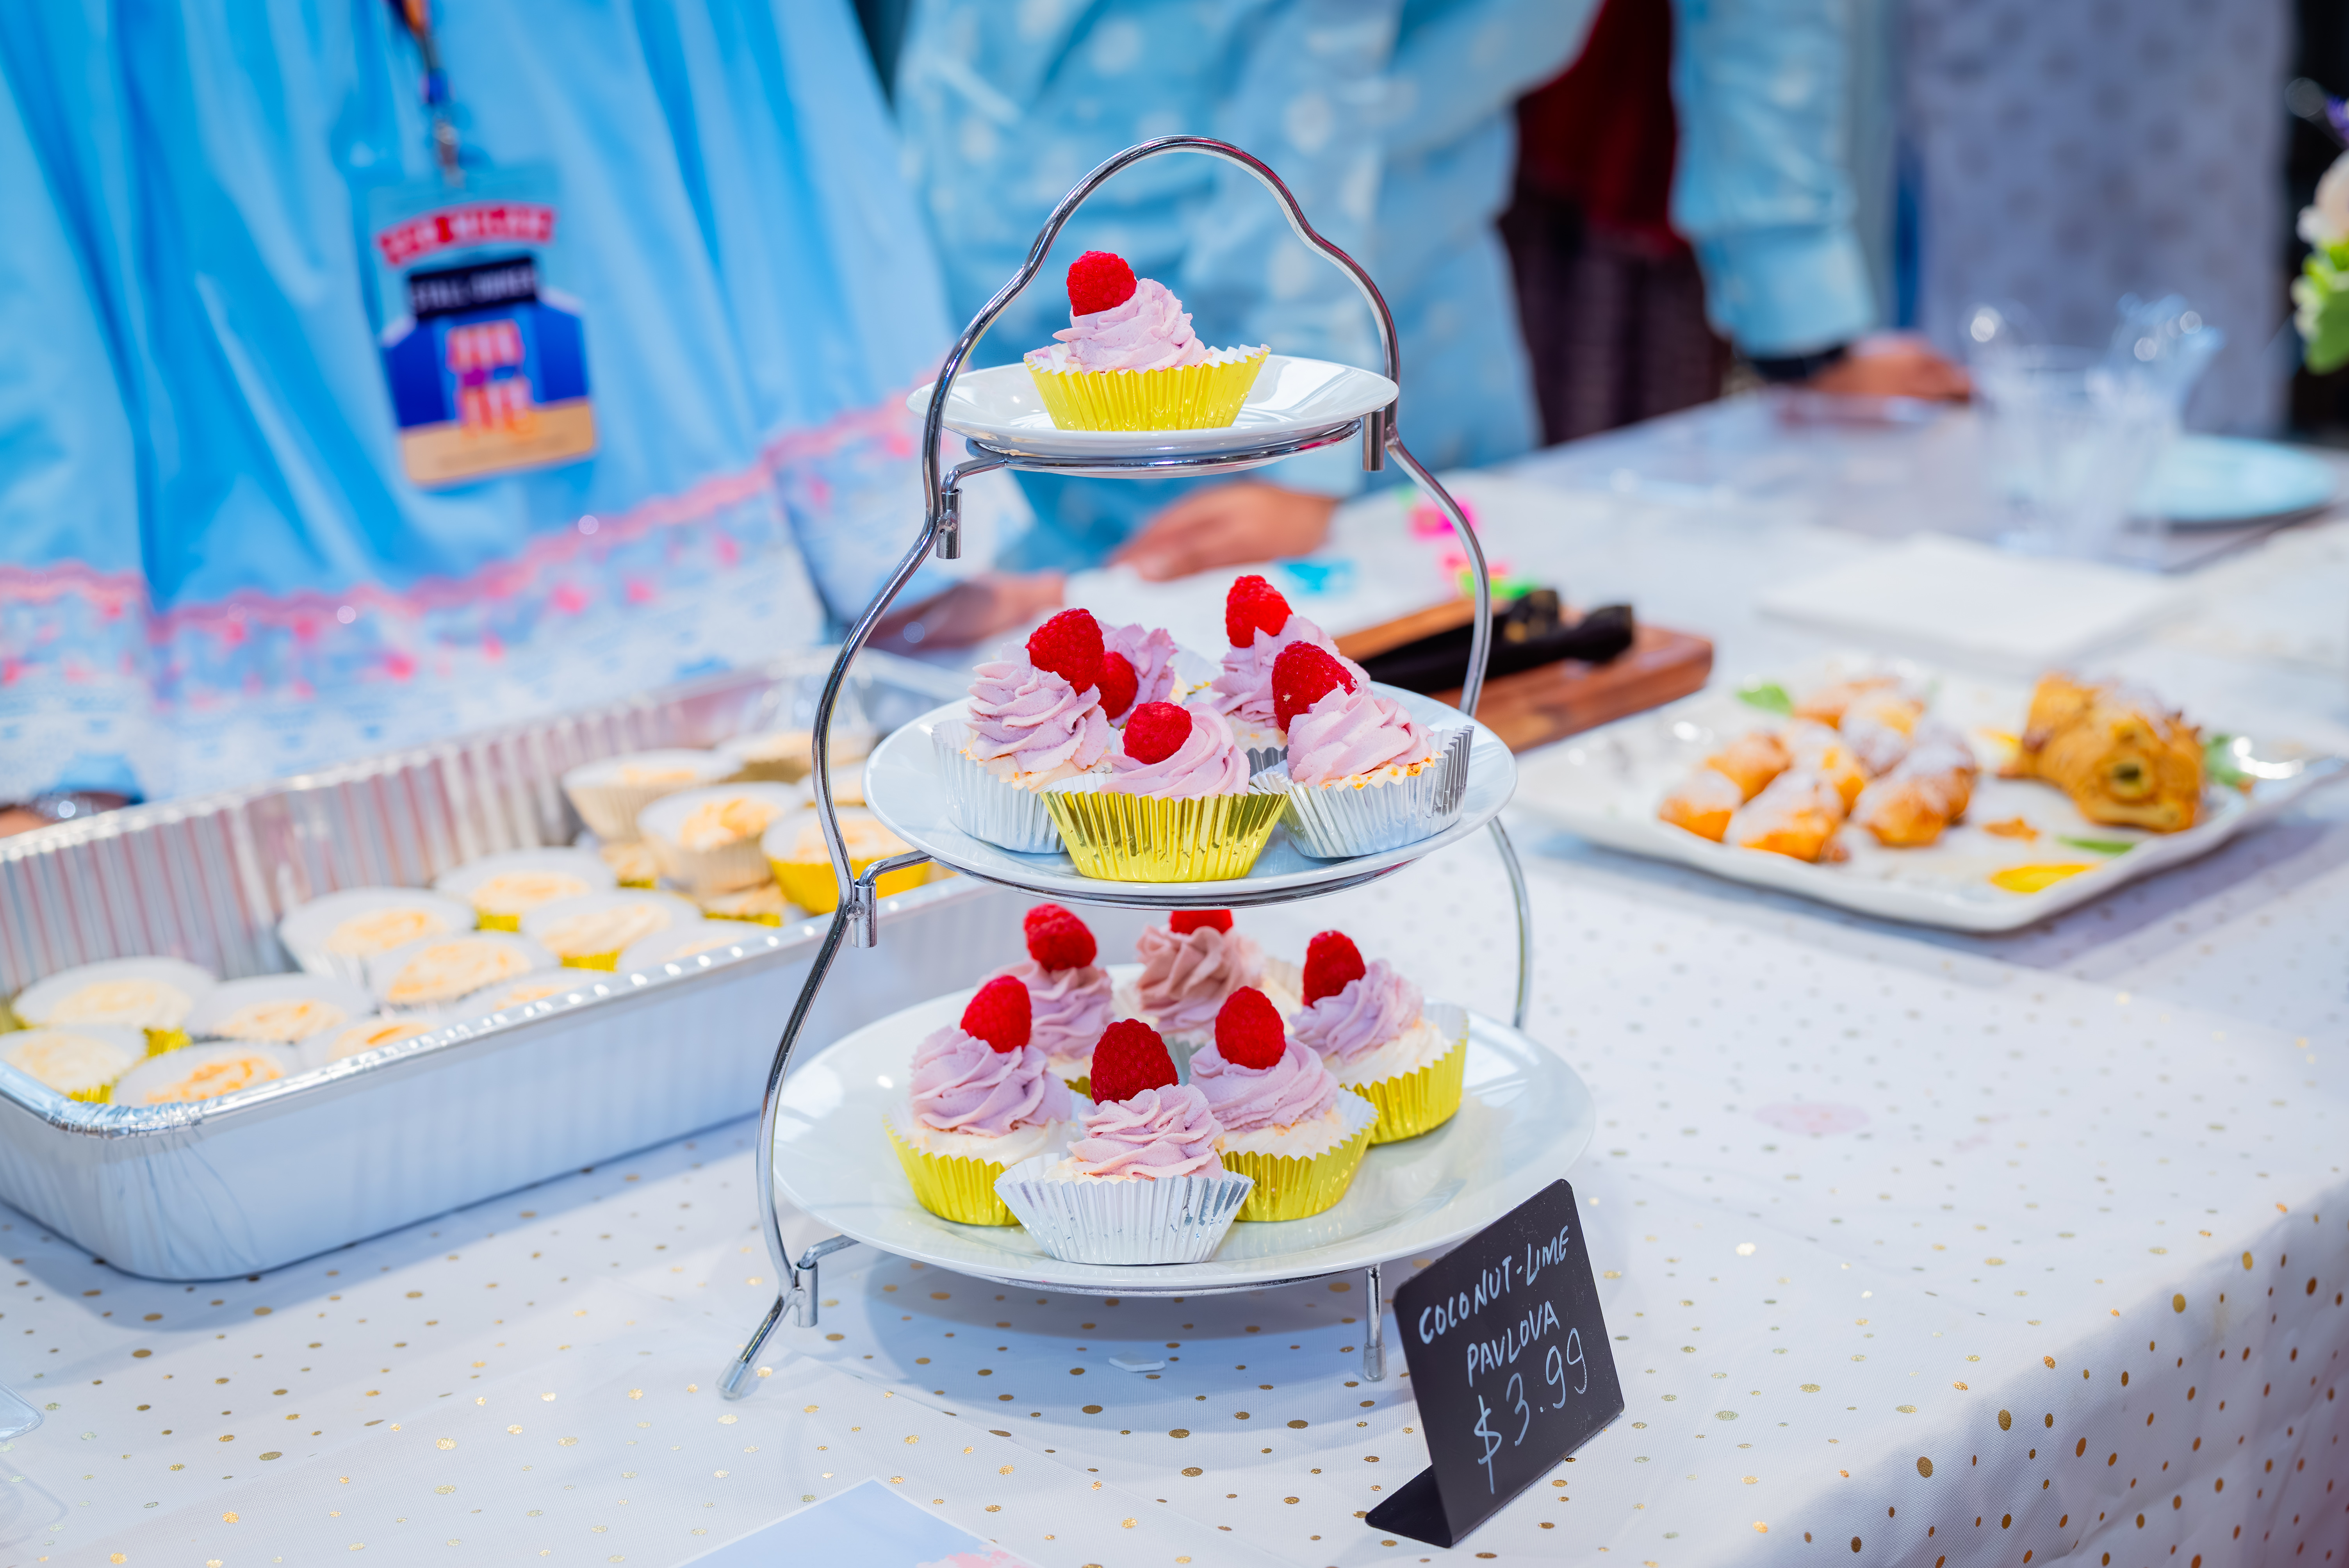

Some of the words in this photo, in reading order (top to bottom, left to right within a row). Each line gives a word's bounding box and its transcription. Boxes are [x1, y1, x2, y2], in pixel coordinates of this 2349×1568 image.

[1419, 1225, 1569, 1345] COCONUT-LIME
[1467, 1301, 1560, 1388] PAVLOVA
[1474, 1327, 1587, 1494] $3.99
